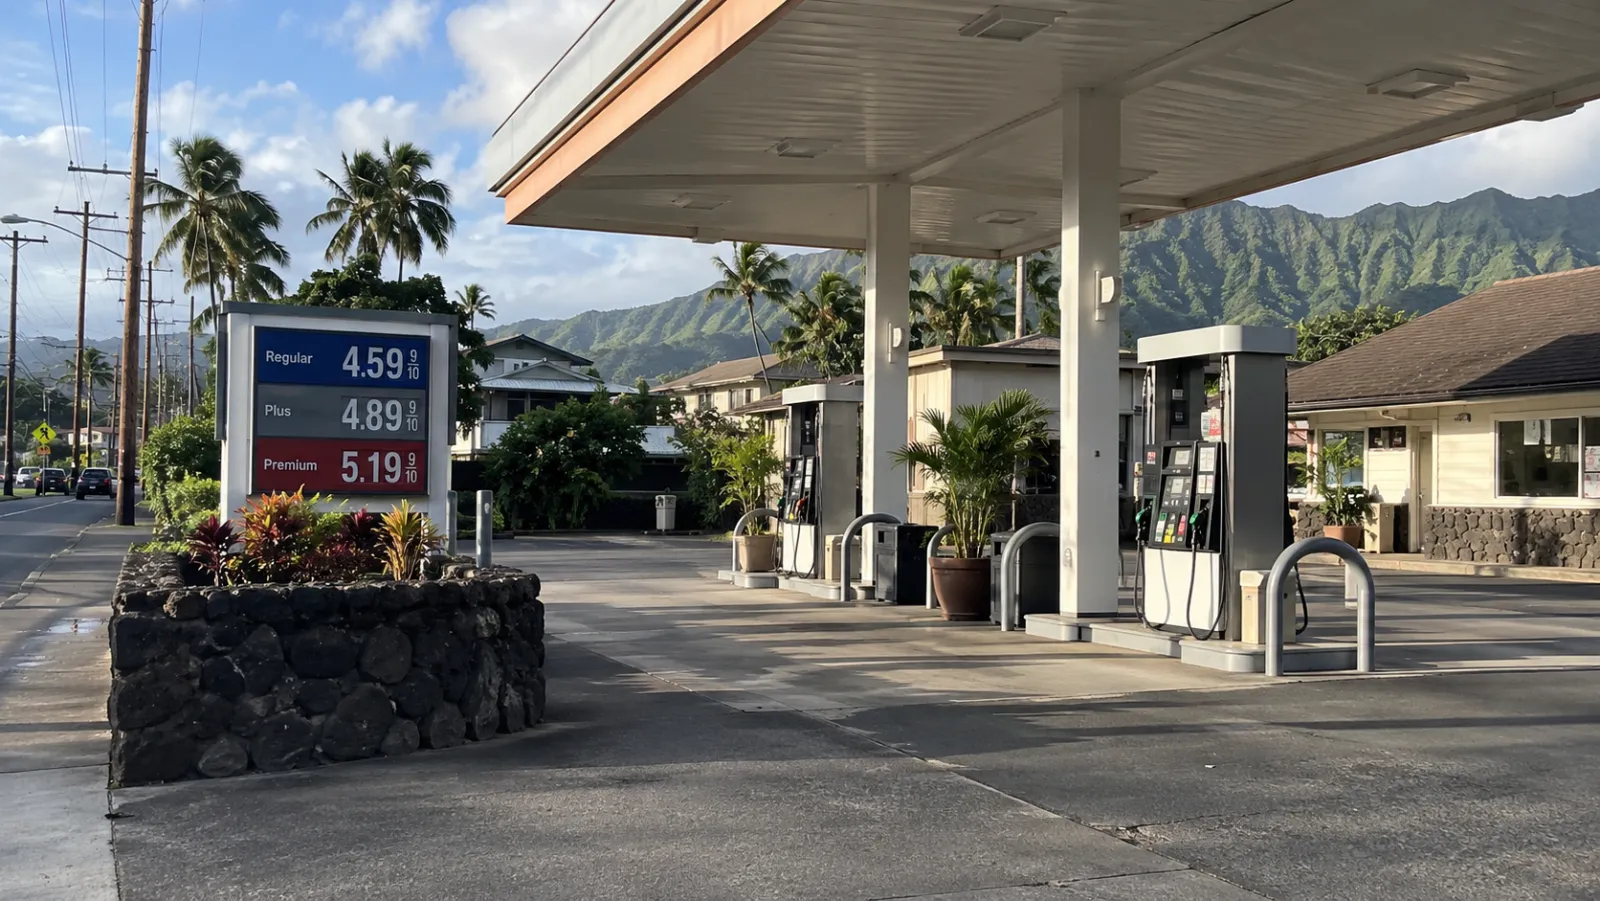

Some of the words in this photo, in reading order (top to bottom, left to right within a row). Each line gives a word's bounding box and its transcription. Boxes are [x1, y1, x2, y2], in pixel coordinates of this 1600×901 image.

[265, 350, 313, 366] Regular
[342, 346, 403, 379] 4.59
[265, 404, 291, 417] Plus
[342, 398, 403, 431] 4.89
[264, 458, 317, 471] Premium
[341, 450, 402, 483] 5.19
